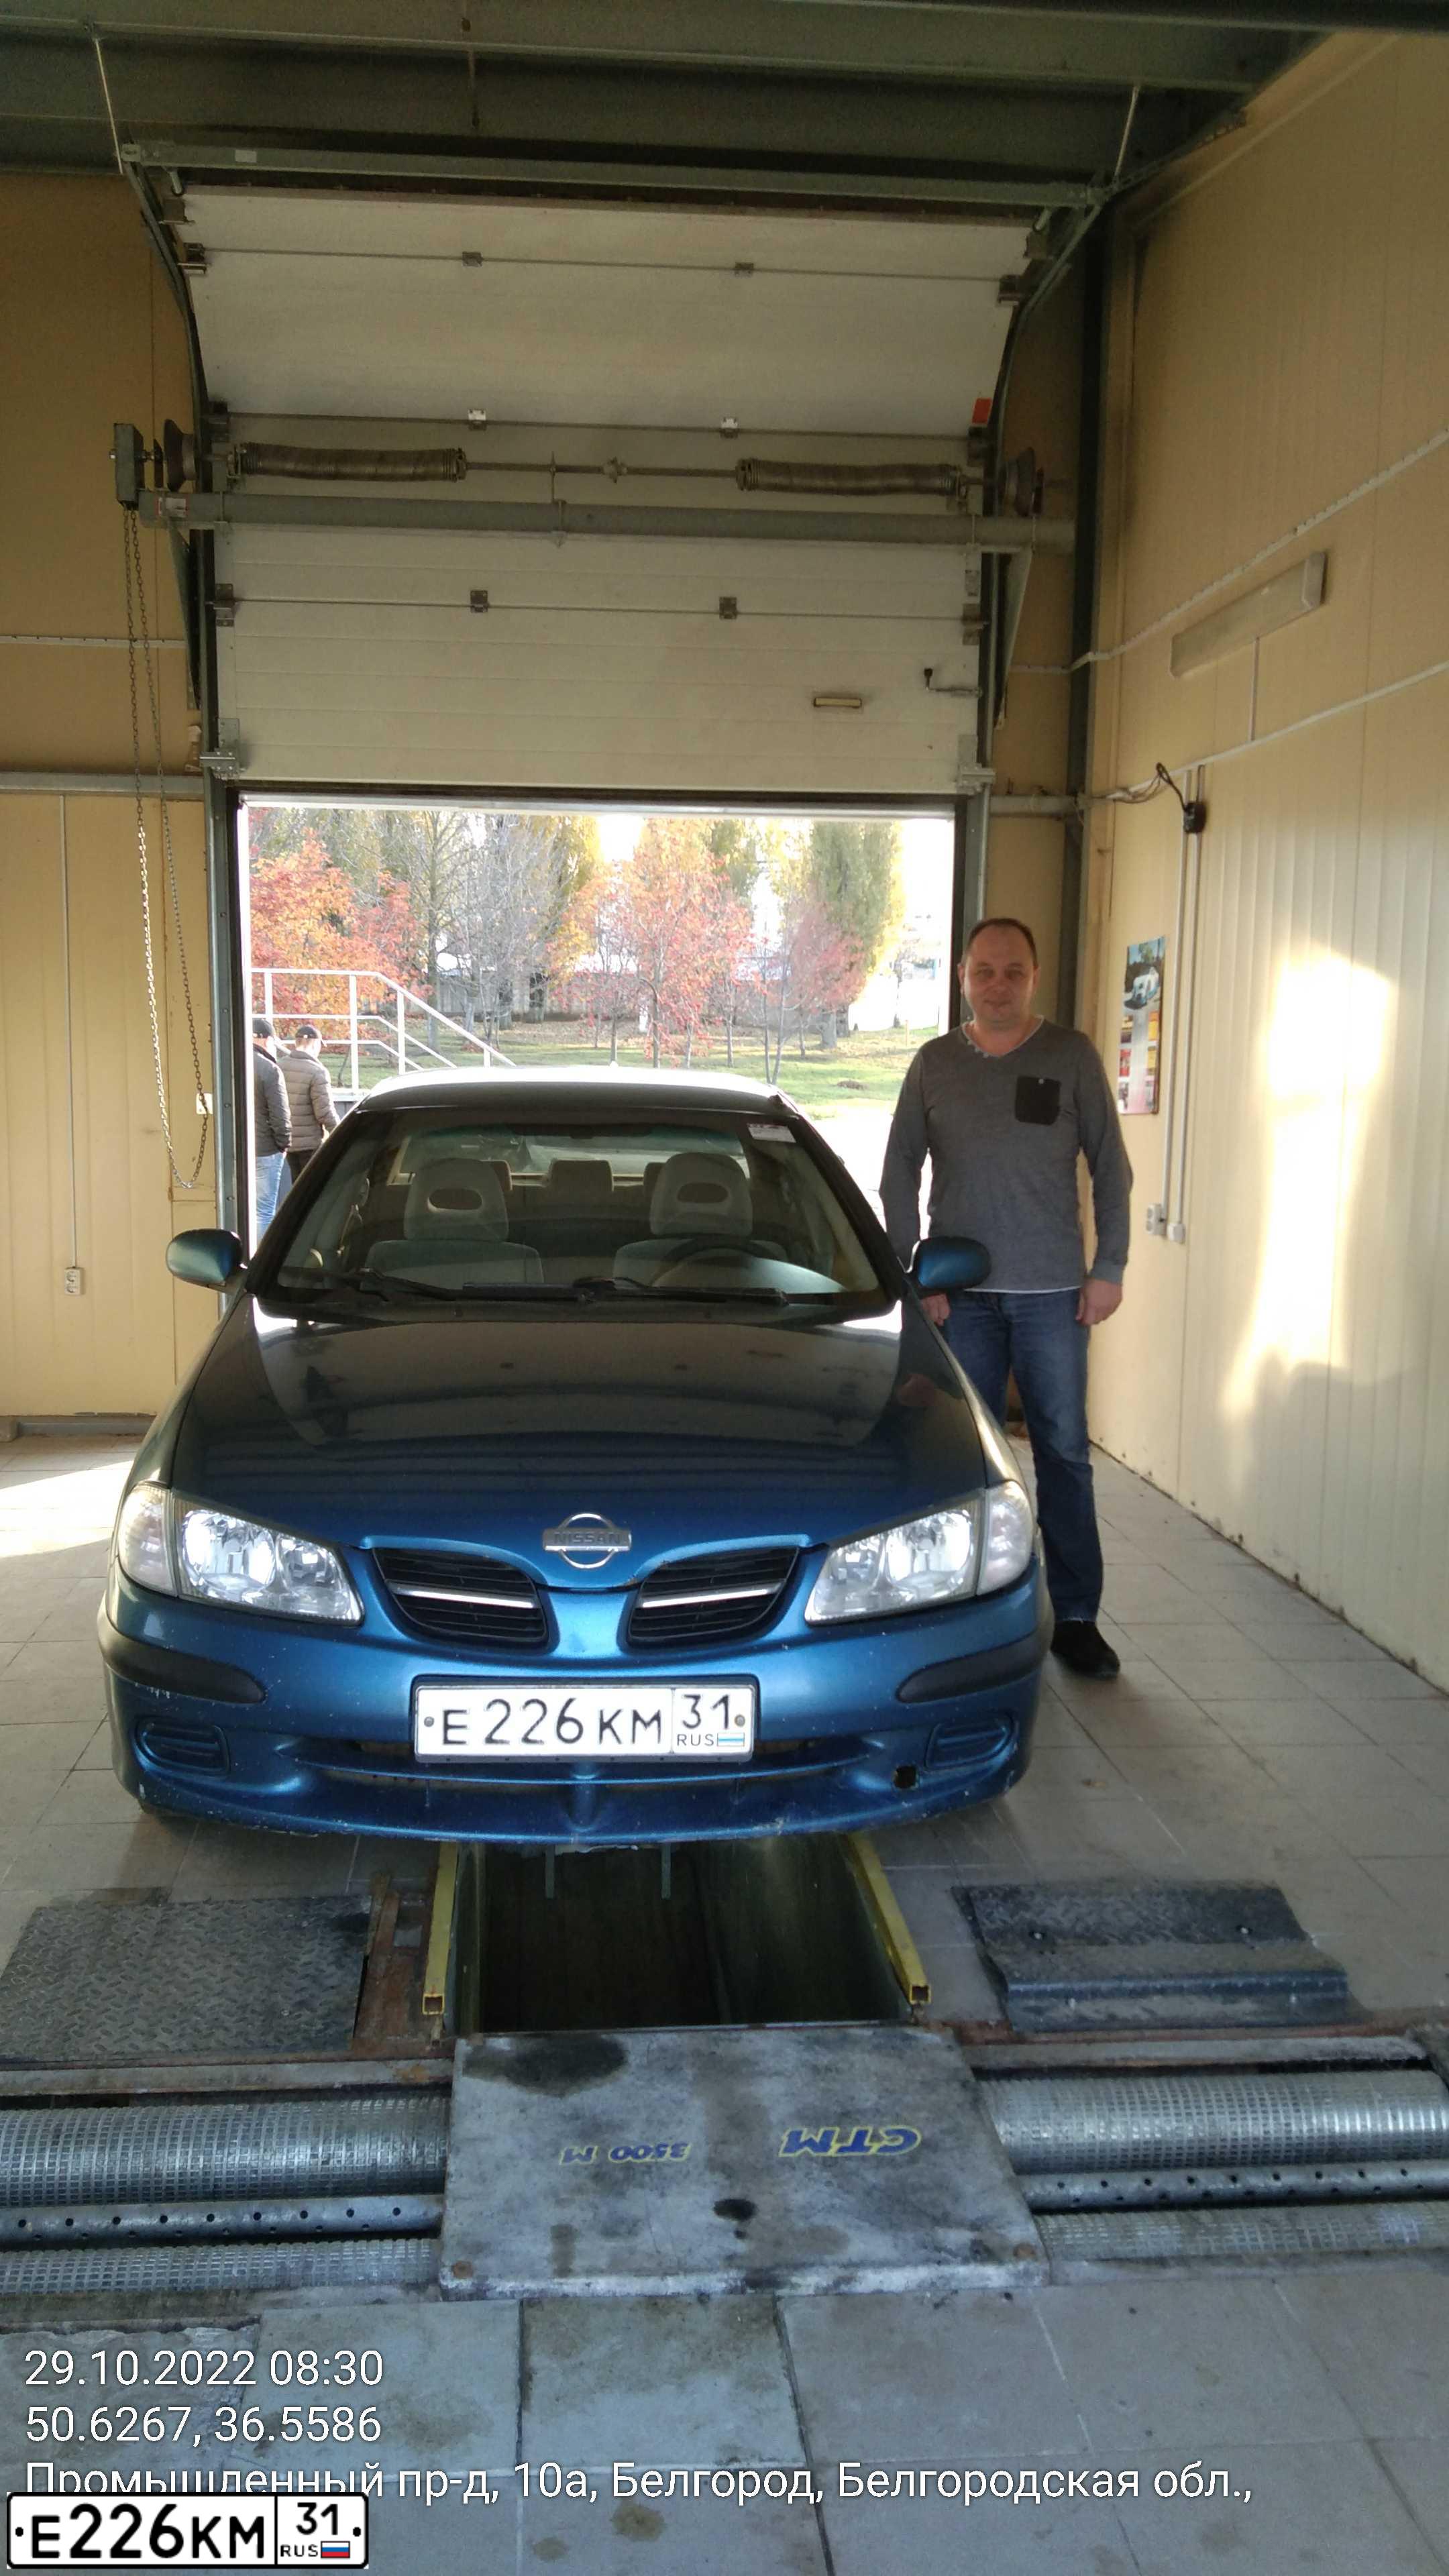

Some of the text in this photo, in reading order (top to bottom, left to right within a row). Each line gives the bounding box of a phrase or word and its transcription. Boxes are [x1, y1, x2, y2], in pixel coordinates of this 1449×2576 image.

[554, 1532, 620, 1544] NISSAN
[682, 1695, 730, 1729] 31
[677, 1733, 714, 1747] RUS
[608, 2142, 692, 2164] 3500
